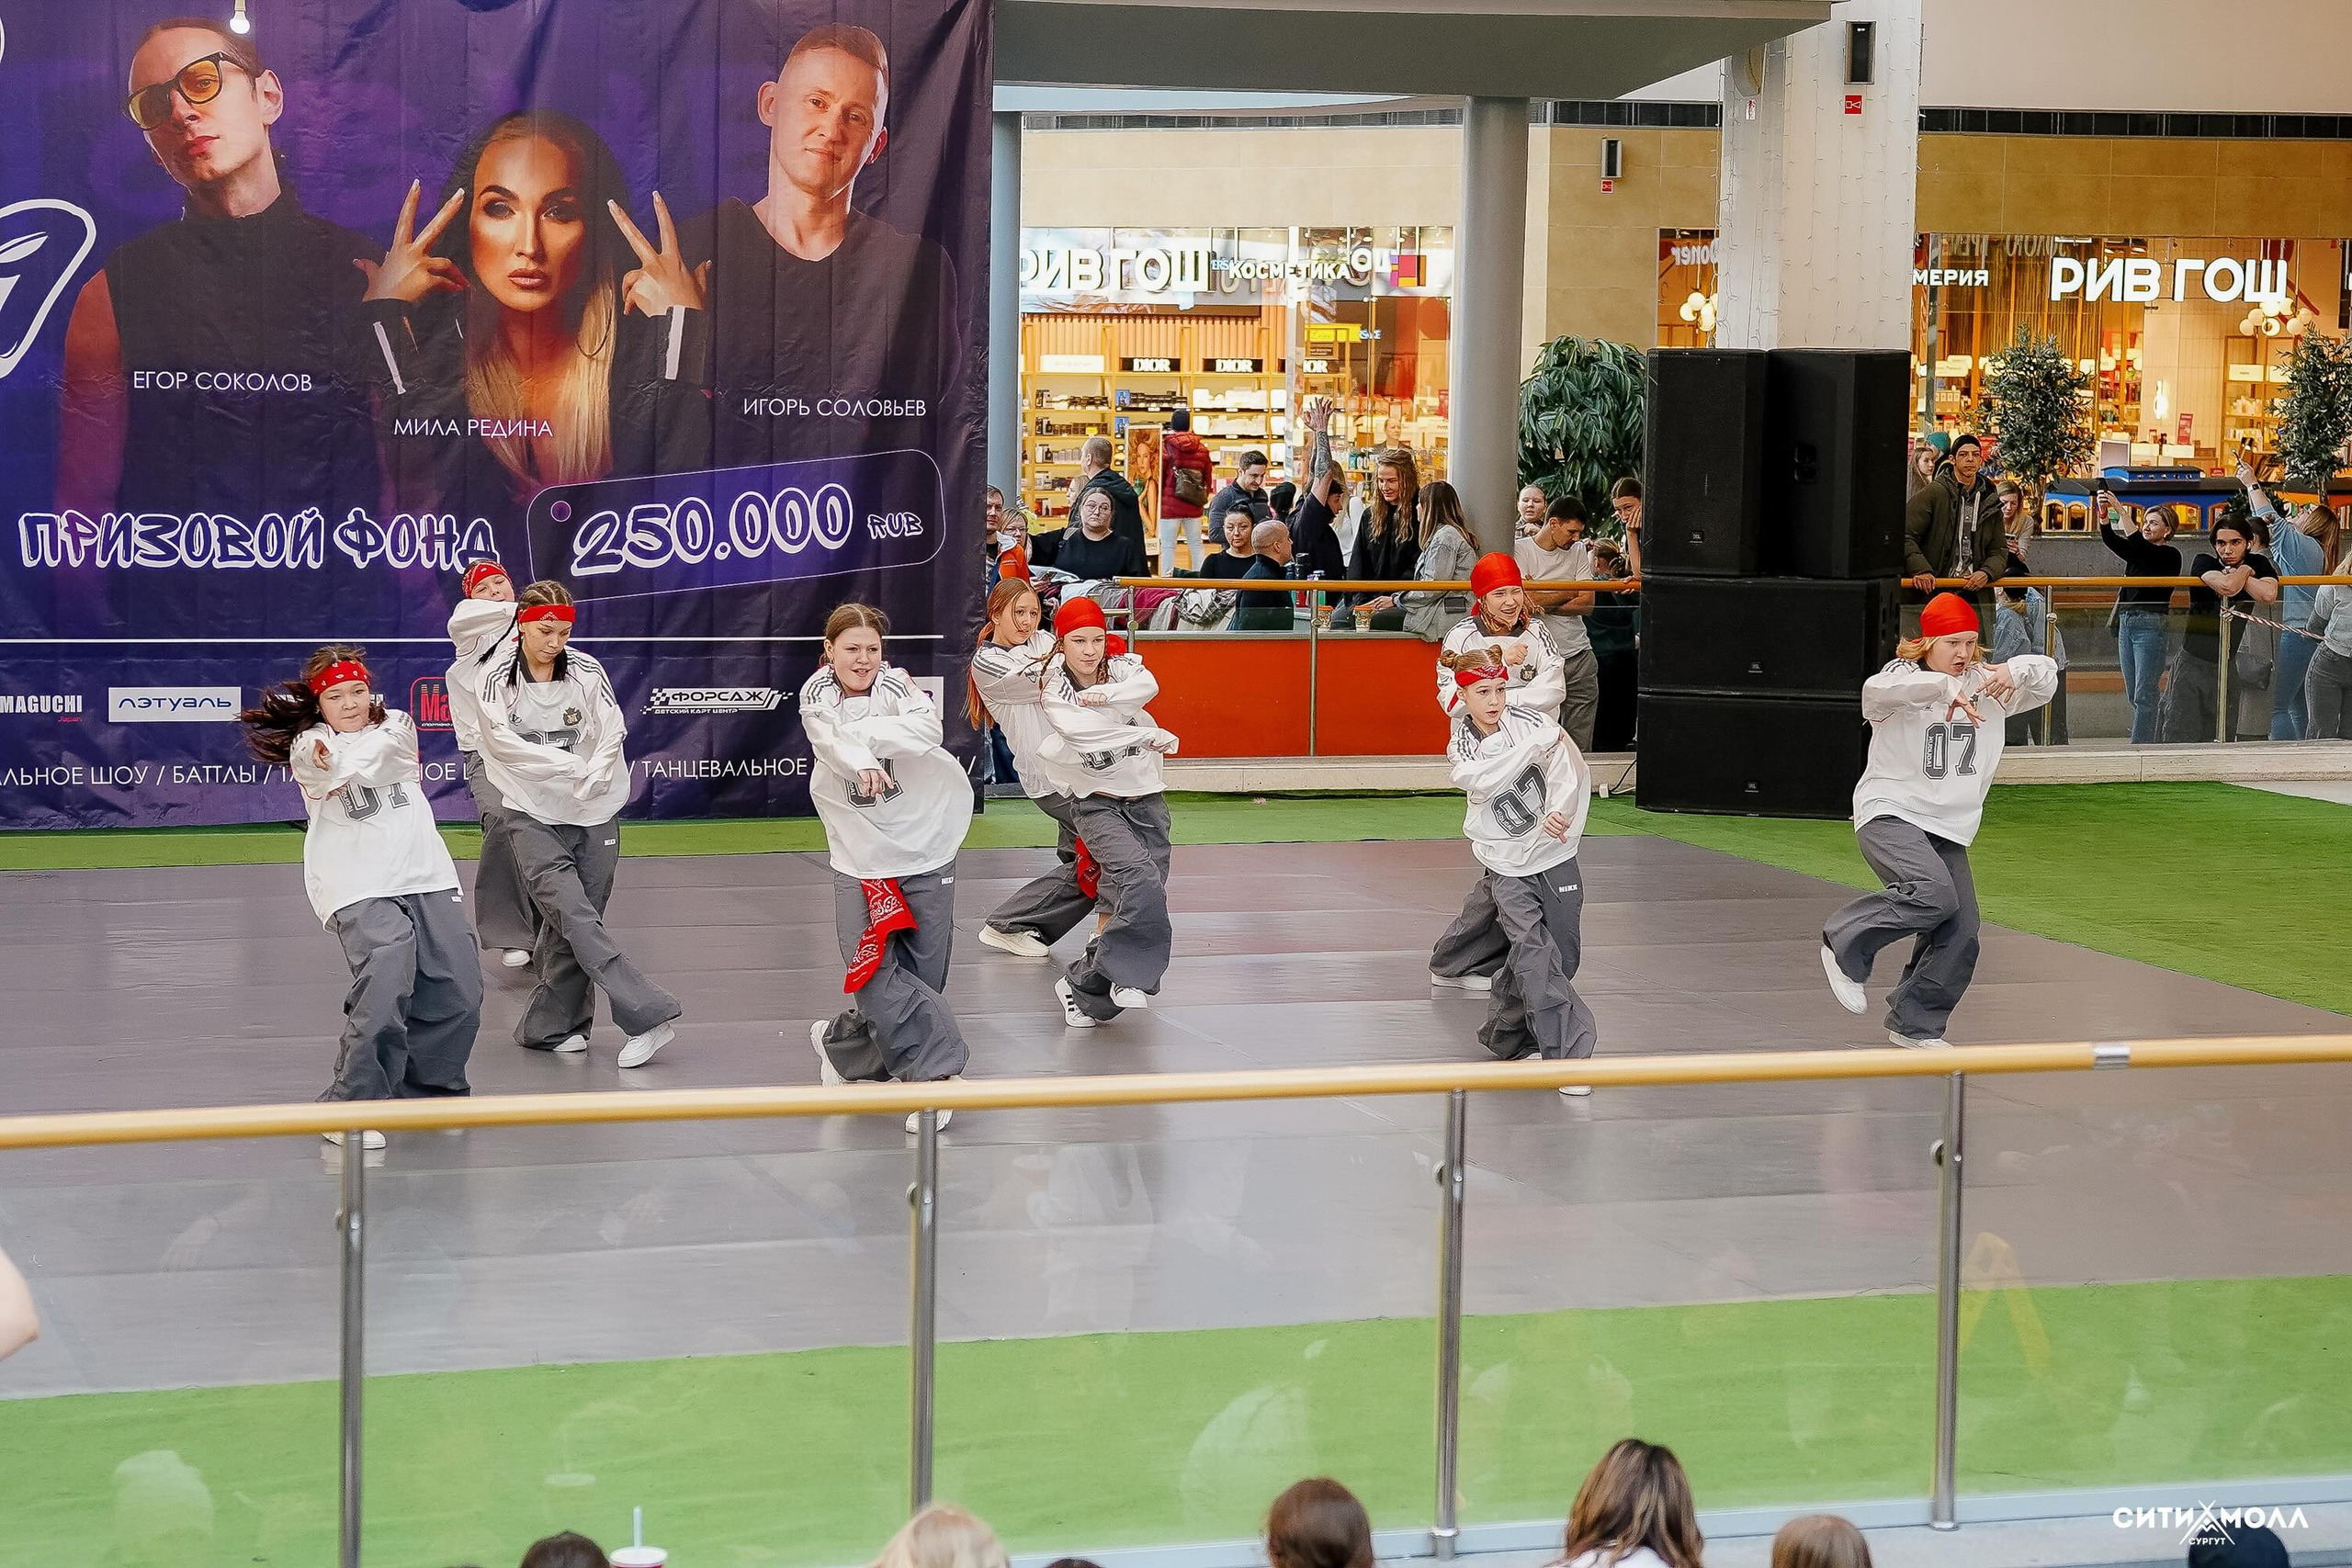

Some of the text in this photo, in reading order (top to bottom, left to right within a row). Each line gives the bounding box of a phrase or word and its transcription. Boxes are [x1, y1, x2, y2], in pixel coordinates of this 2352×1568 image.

[1111, 248, 1211, 293] ГОШ
[1228, 260, 1351, 280] КОСМЕТИКА
[1911, 268, 1990, 288] МЕРИЯ
[2050, 257, 2289, 303] РИВ ГОШ
[1132, 357, 1171, 373] DIOR
[1215, 358, 1254, 374] DIOR
[1302, 359, 1329, 374] IOR
[132, 370, 313, 393] ЕГОР СОКОЛОВ
[743, 398, 927, 419] ИГОРЬ СОЛОВЬЕВ
[393, 418, 554, 440] МИЛА РЕДИНА
[18, 505, 500, 574] ПРИЗОВОЙ ФОНД
[569, 482, 924, 578] 250.000 RUB
[0, 694, 84, 715] MAGUCHI
[671, 691, 765, 702] ФОРСАЖ
[1922, 722, 1977, 781] 07
[0, 766, 85, 787] ЛЬНОЕ
[90, 765, 150, 786] ШОУ
[172, 764, 256, 785] БАТТЛЫ
[641, 758, 808, 781] ТАНЦЕВАЛЬНОЕ
